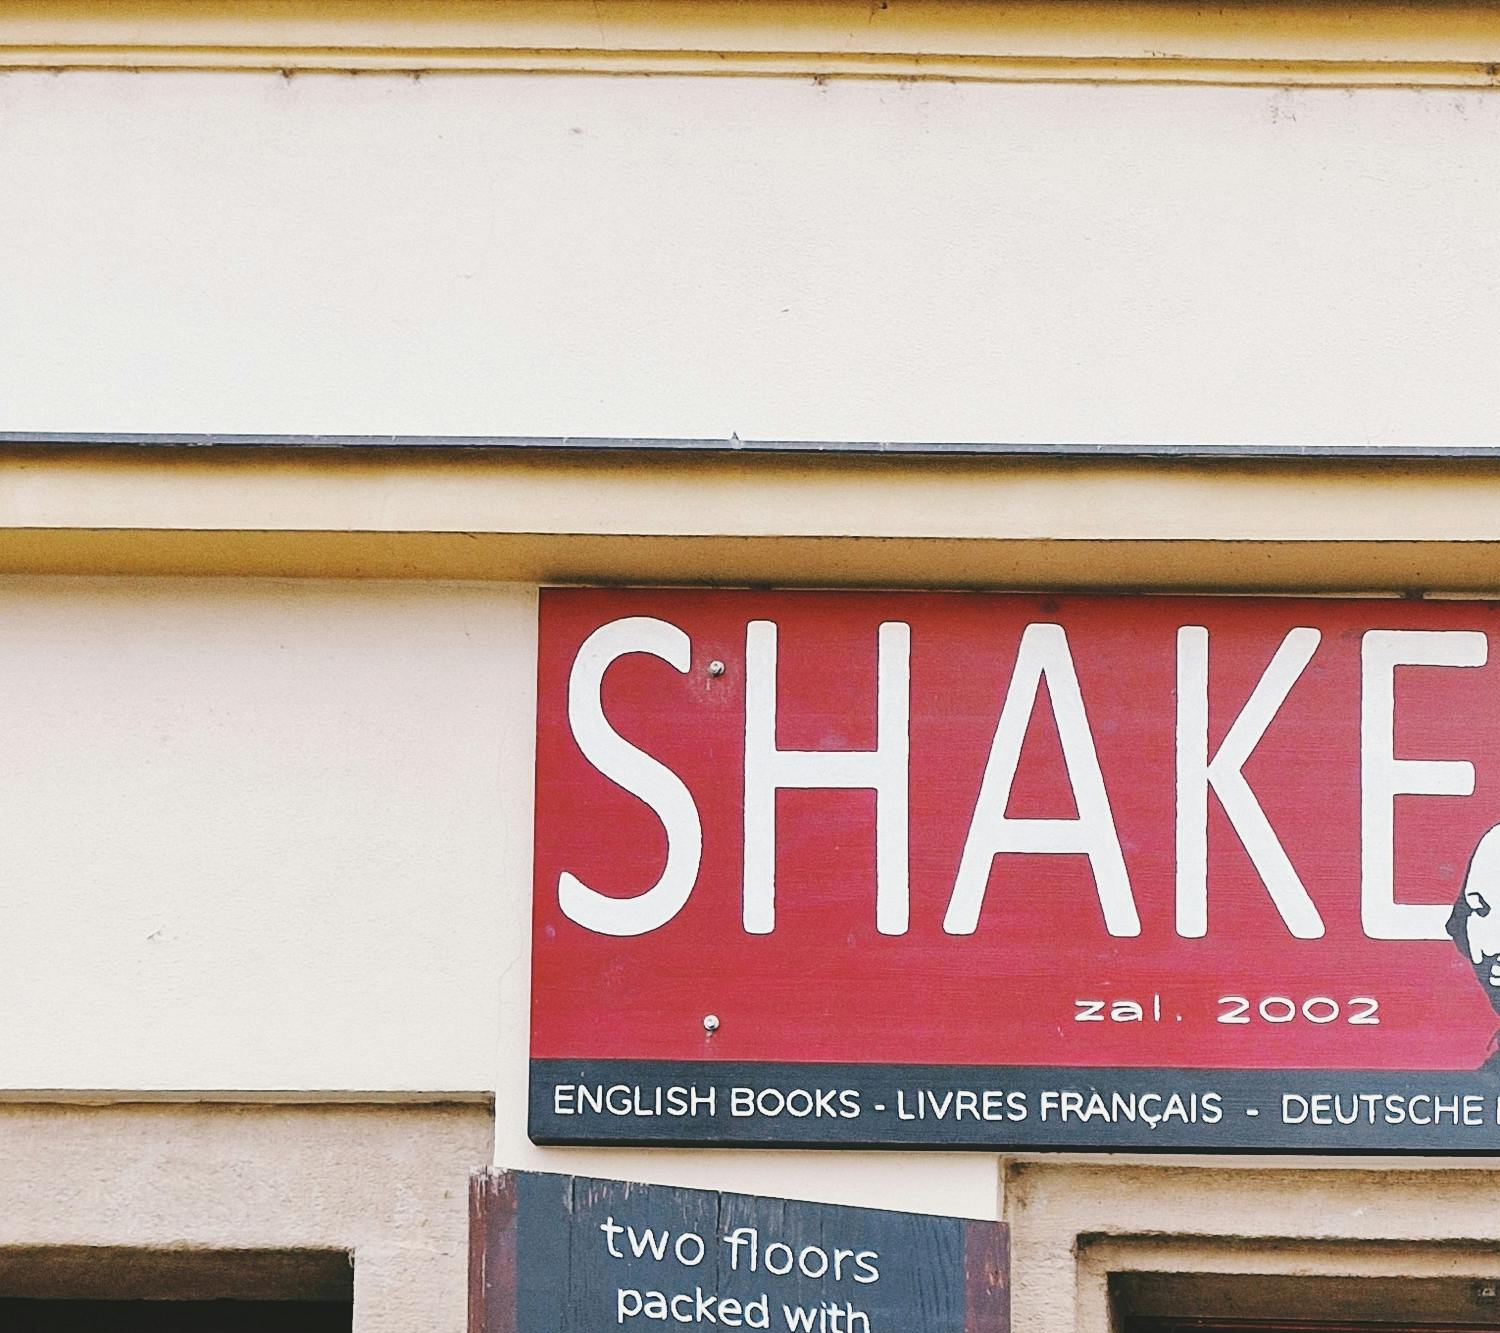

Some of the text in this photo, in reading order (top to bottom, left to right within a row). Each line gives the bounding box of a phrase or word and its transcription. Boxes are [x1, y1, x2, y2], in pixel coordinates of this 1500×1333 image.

[1074, 995, 1381, 1025] zal. 2002
[554, 1082, 716, 1117] ENGLISH
[730, 1087, 861, 1120] BOOKS
[897, 1089, 1027, 1123] LIVRES
[1039, 1091, 1223, 1131] FRANÇAIS
[1281, 1092, 1485, 1127] DEUTSCHE
[600, 1216, 881, 1284] two floors
[617, 1287, 769, 1330] packed
